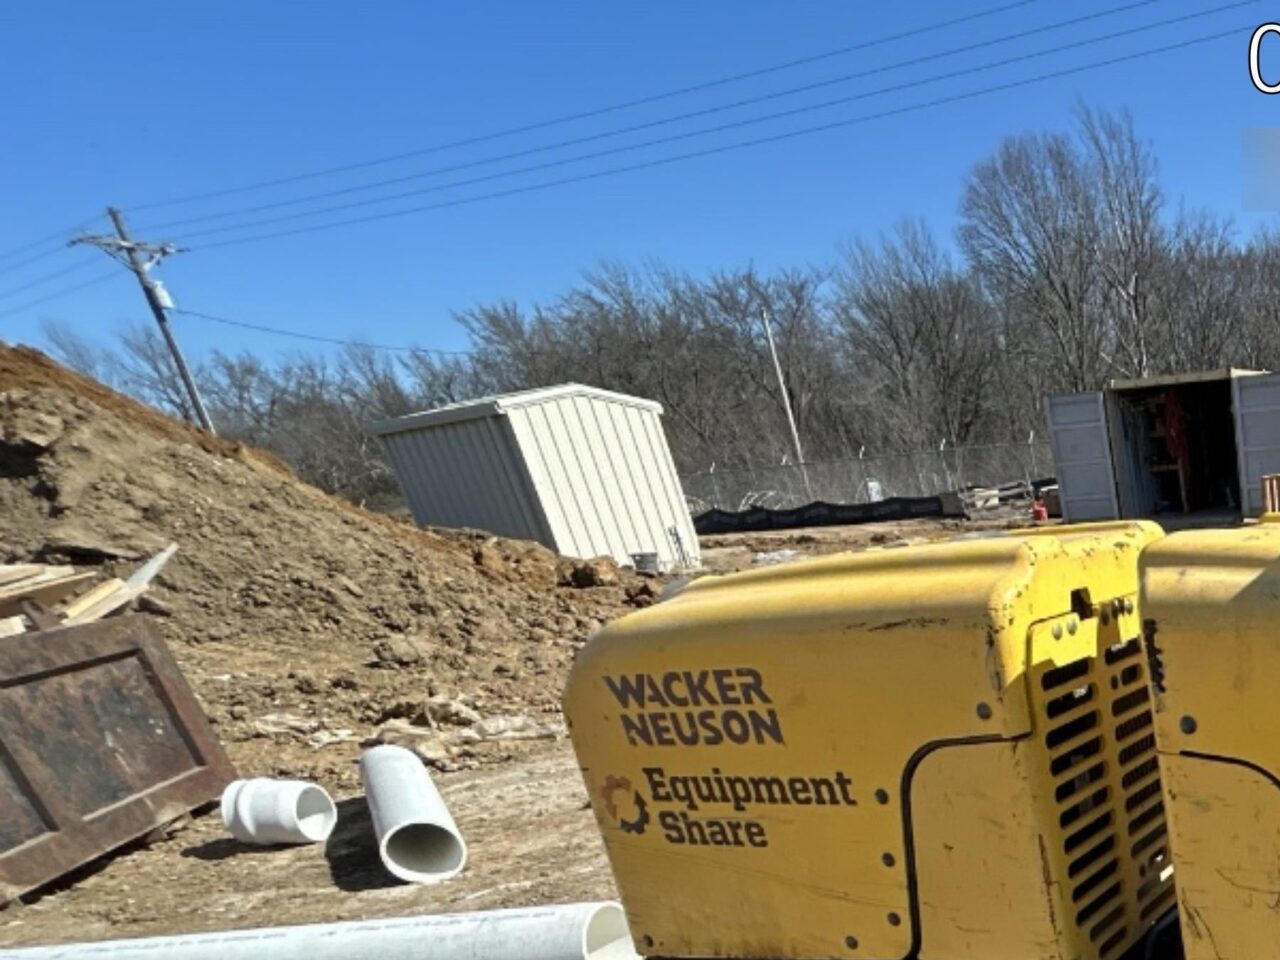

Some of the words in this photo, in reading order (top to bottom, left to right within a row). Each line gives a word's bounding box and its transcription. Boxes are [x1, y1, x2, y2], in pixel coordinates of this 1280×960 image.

[603, 667, 773, 709] WACKER
[620, 709, 785, 746] NEUSON
[642, 767, 858, 812] Equipment
[658, 811, 769, 848] Share
